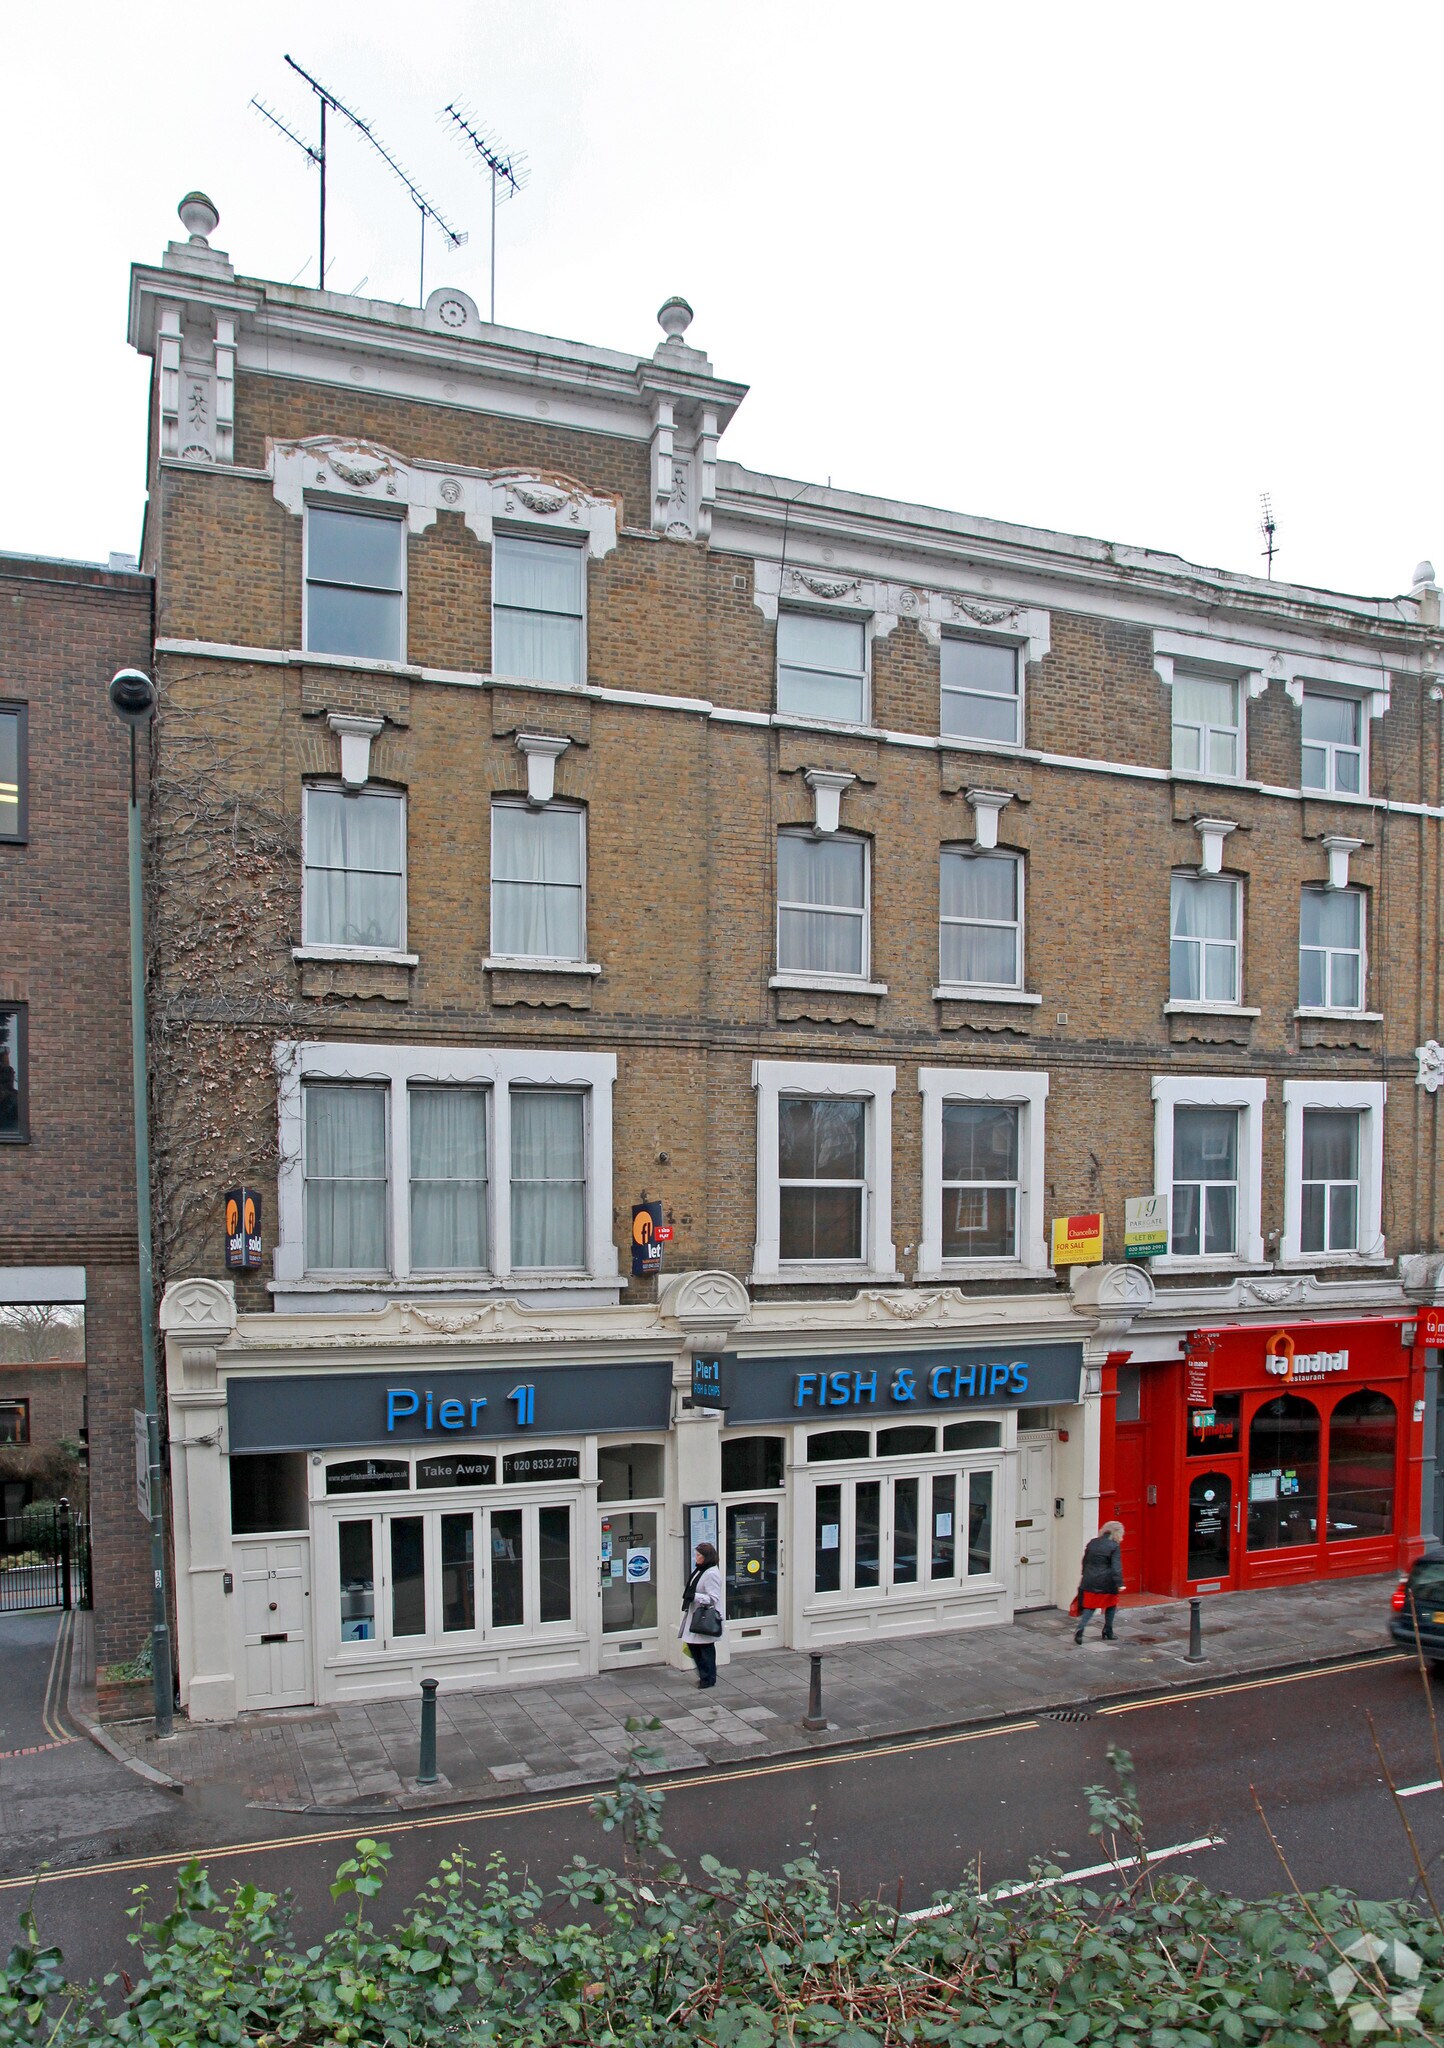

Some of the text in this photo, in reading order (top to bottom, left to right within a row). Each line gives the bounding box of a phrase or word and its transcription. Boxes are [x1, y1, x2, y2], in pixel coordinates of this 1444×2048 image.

[1069, 1228, 1098, 1237] Chancellors
[230, 1233, 242, 1250] sold
[249, 1236, 261, 1252] sold
[648, 1244, 661, 1258] let
[695, 1359, 712, 1379] Pier
[693, 1383, 703, 1394] FISH
[708, 1385, 720, 1397] CHIPS
[793, 1361, 1029, 1407] FISH & CHIPS
[386, 1384, 535, 1432] Pier 1
[423, 1464, 490, 1477] Take Away
[504, 1457, 578, 1471] T: 020 8332 2778
[268, 1570, 277, 1579] 13
